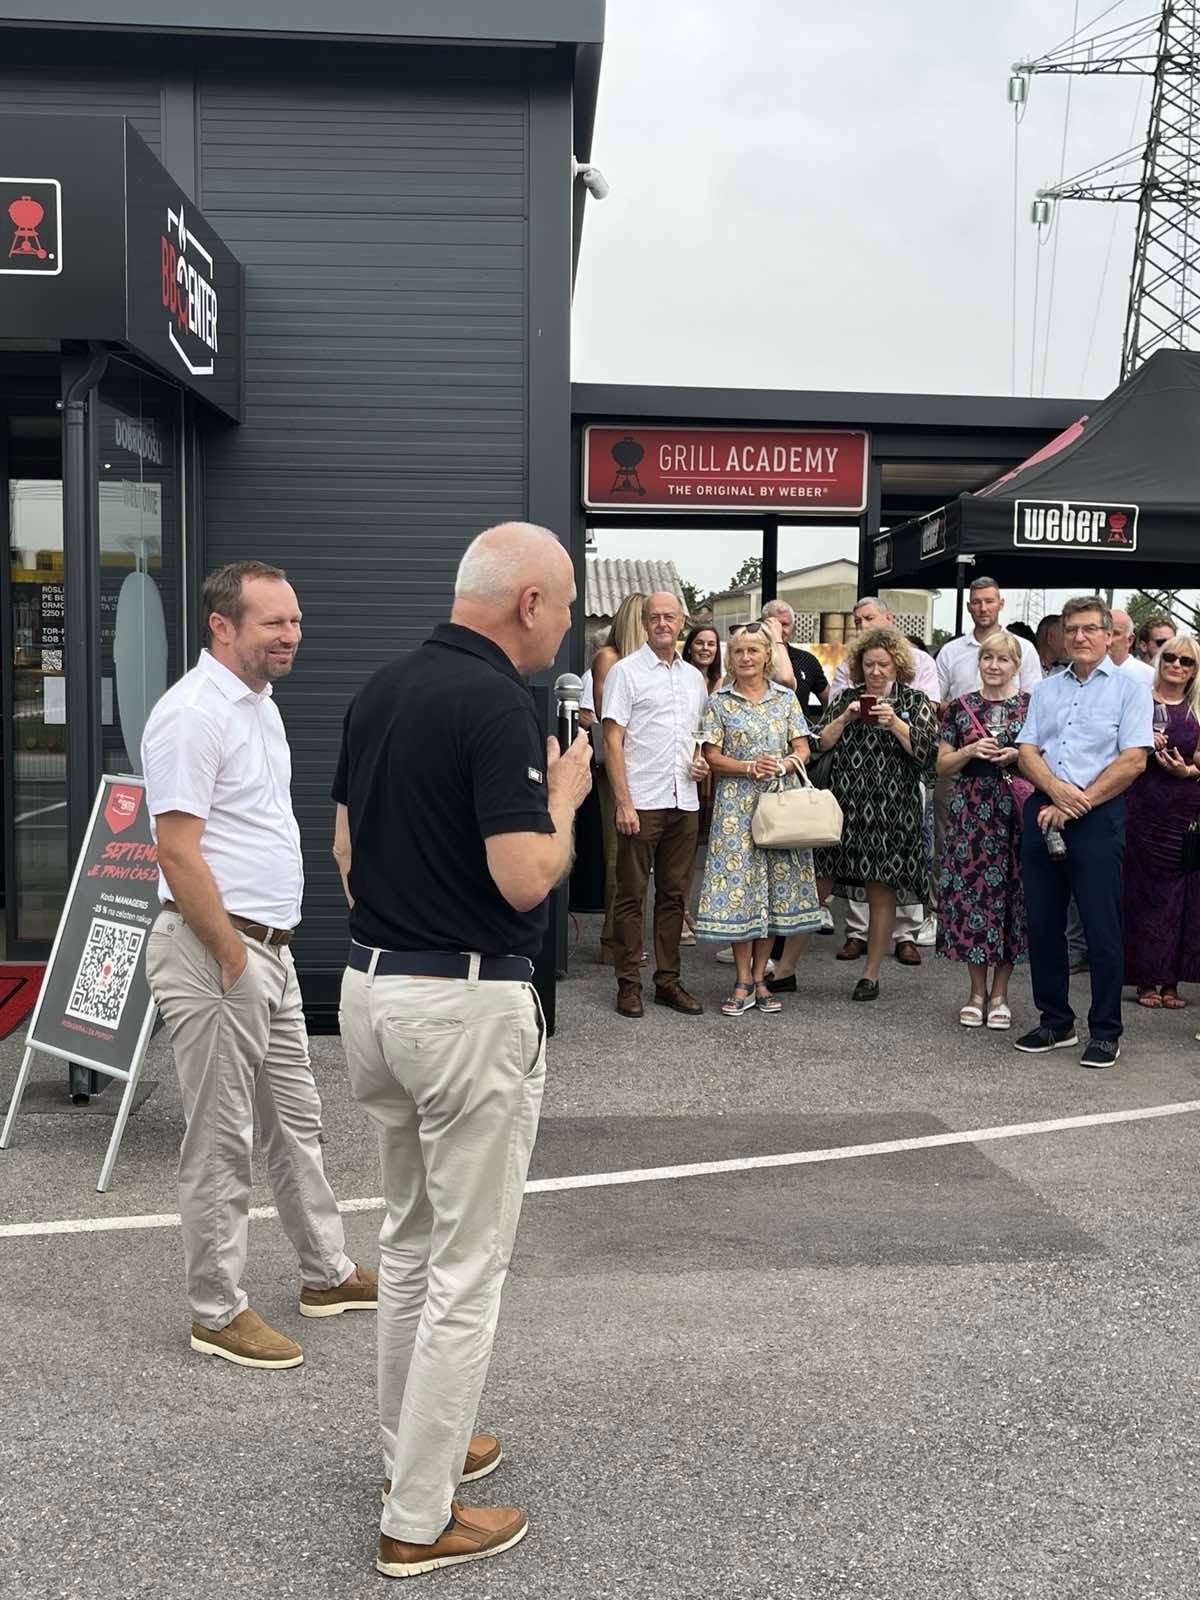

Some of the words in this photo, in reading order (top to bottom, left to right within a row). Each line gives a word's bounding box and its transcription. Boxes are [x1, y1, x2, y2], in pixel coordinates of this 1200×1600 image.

[658, 444, 721, 472] GRILL
[725, 446, 839, 473] ACADEMY
[668, 484, 693, 496] THE
[696, 485, 755, 497] ORIGINAL
[760, 486, 775, 497] BY
[1023, 502, 1107, 543] weber
[42, 635, 59, 643] SOB
